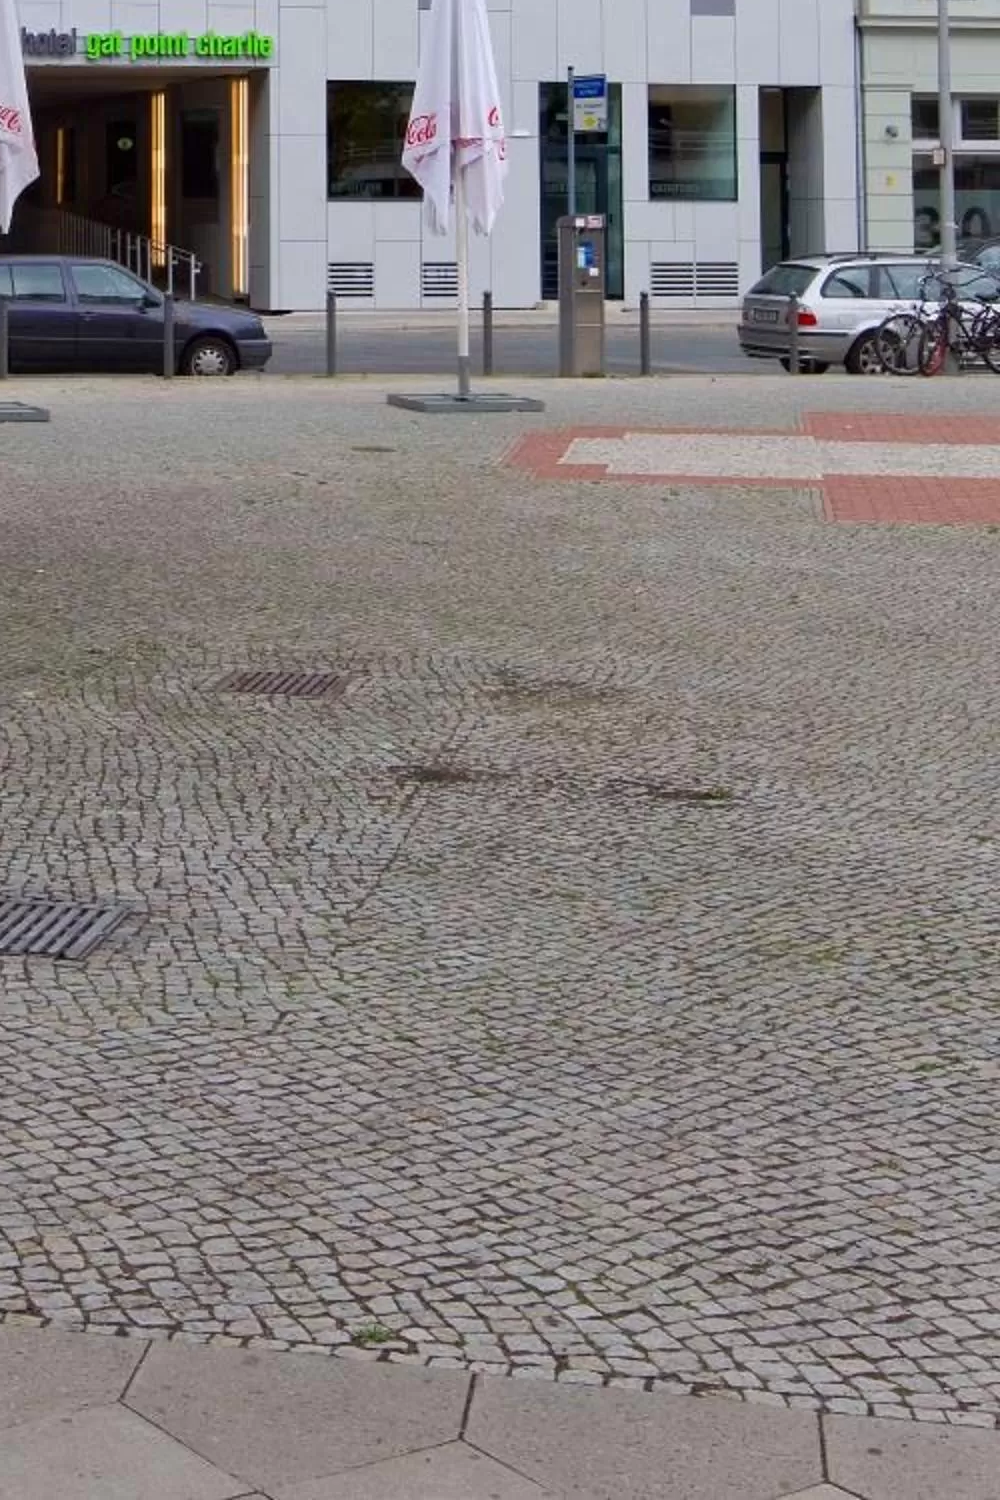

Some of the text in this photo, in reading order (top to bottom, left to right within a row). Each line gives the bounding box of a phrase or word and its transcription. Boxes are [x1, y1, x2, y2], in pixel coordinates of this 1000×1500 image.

[22, 28, 77, 56] hotel
[131, 30, 188, 60] point
[196, 30, 273, 57] charlie
